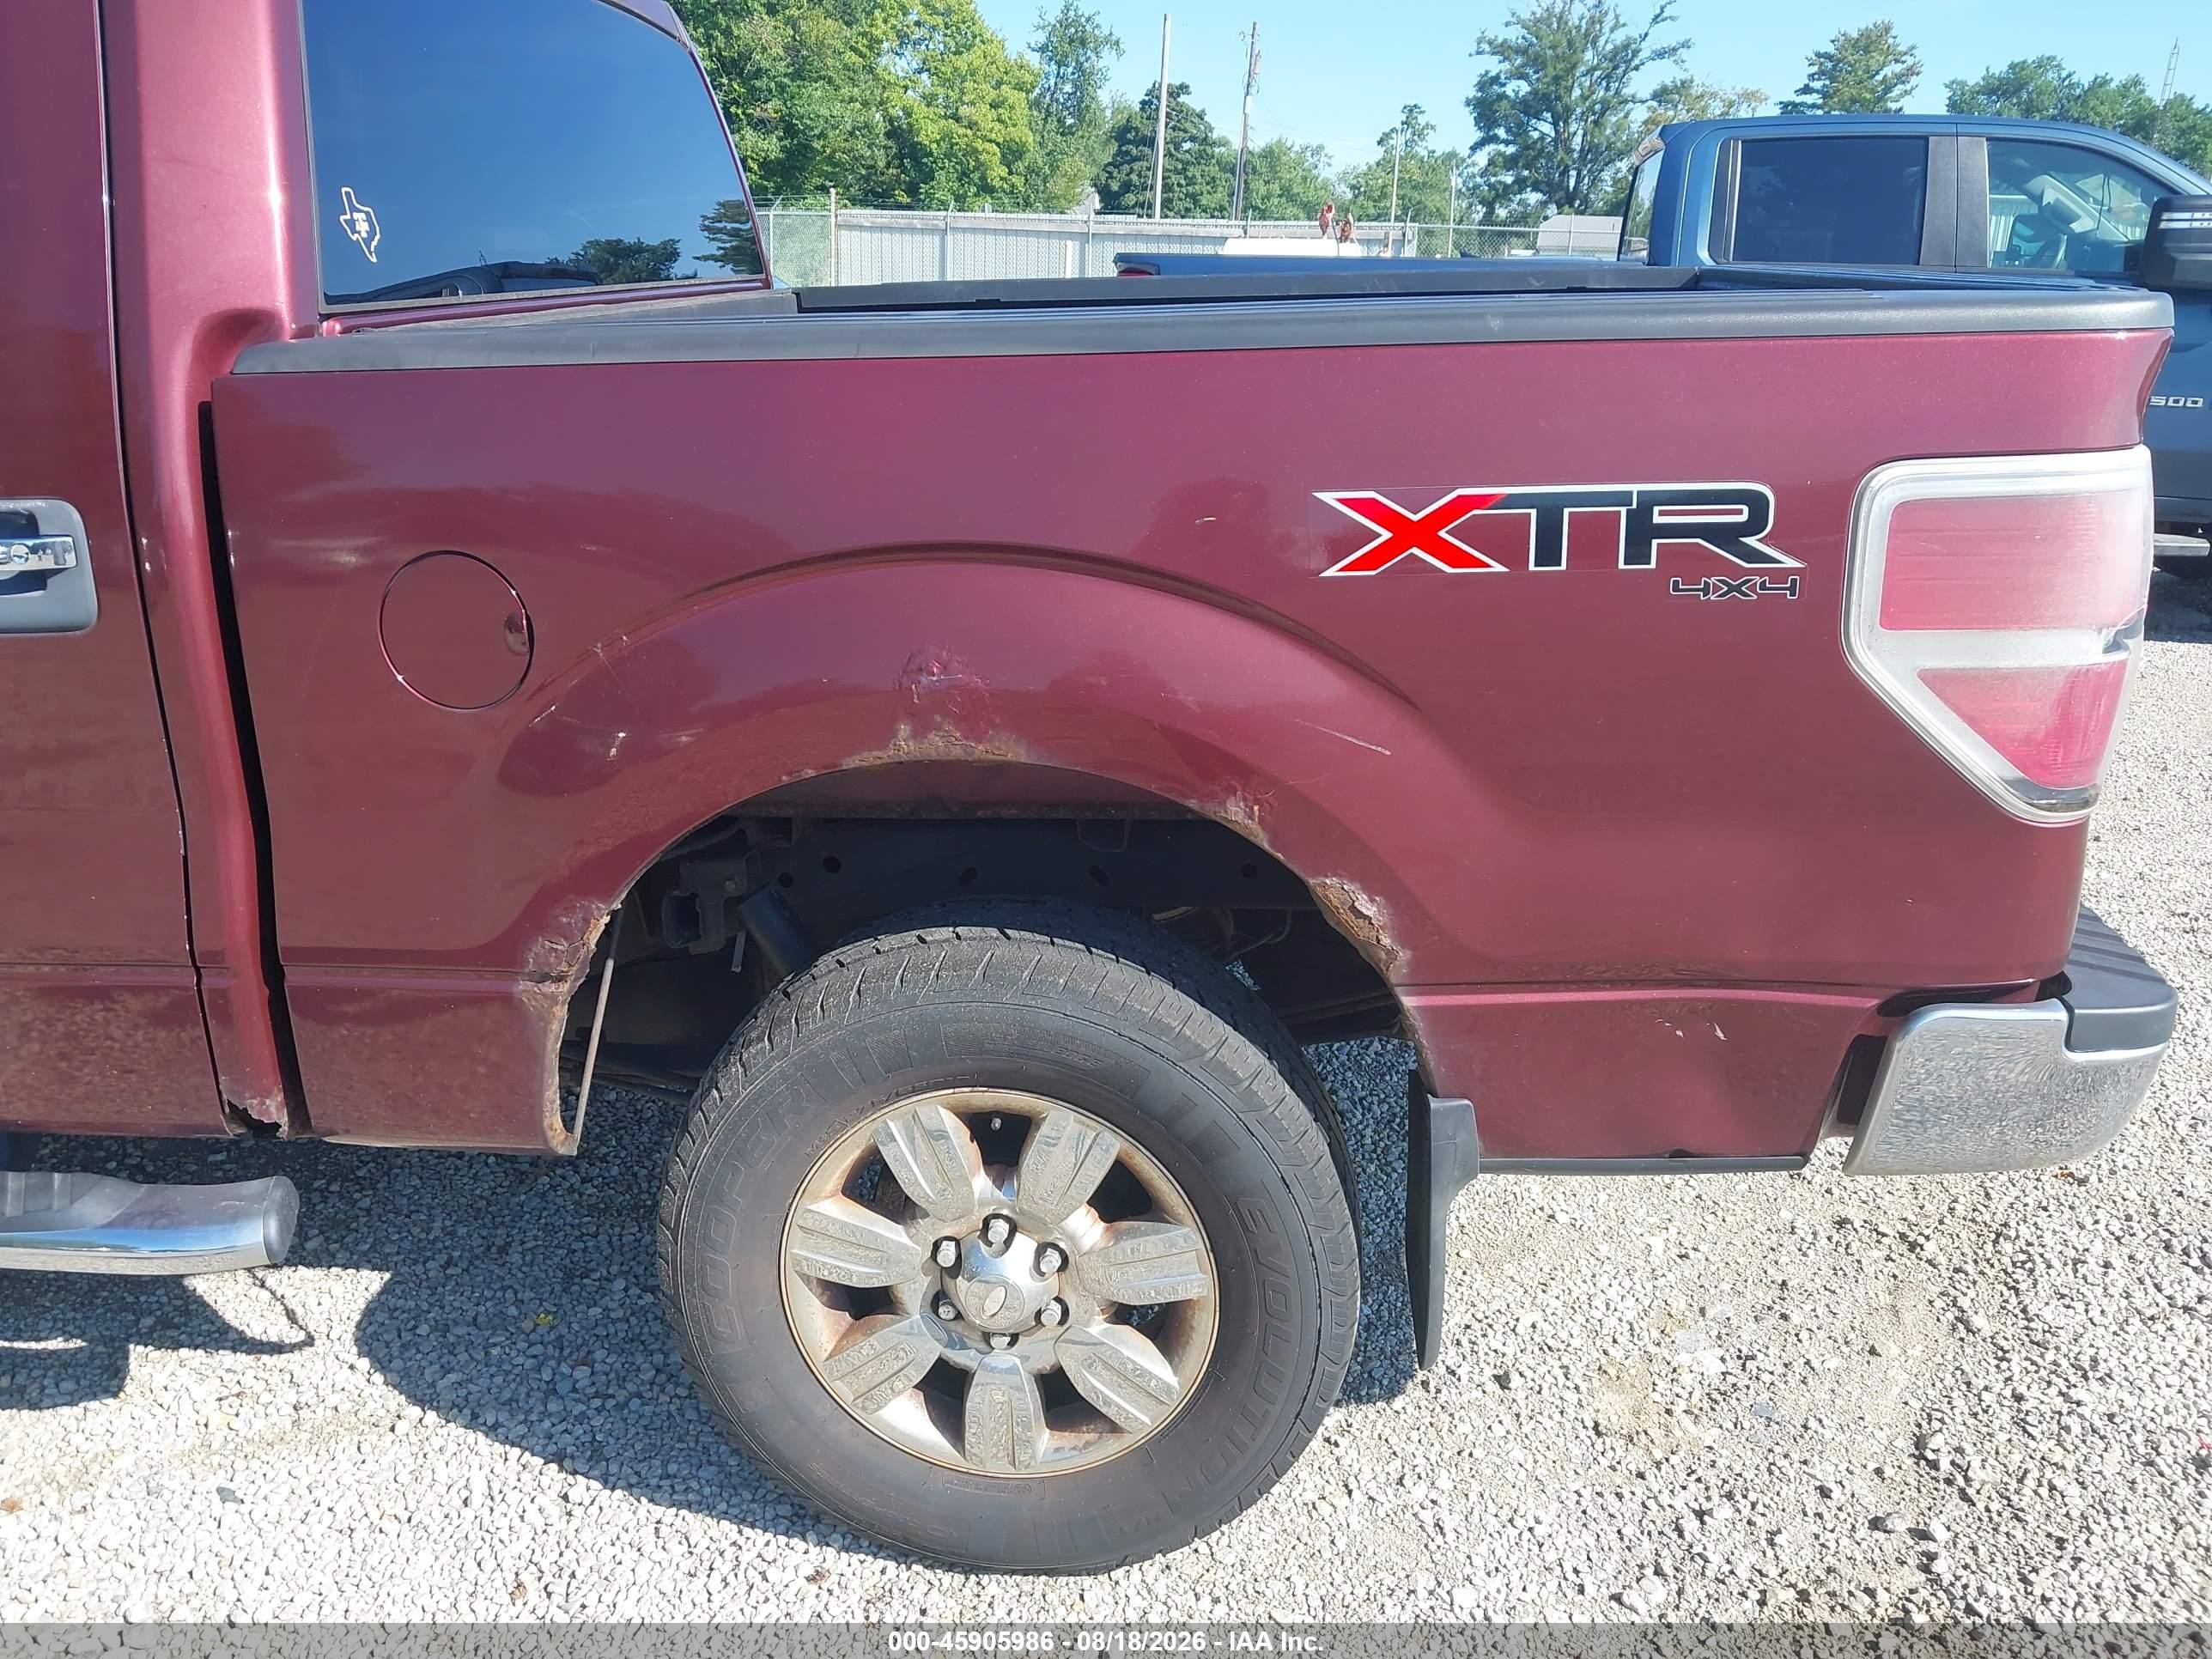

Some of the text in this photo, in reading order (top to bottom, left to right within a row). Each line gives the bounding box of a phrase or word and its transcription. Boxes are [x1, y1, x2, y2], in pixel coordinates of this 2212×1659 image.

[2149, 396, 2203, 407] 500
[1310, 481, 1807, 577] XTR
[697, 1079, 811, 1343] COOPER
